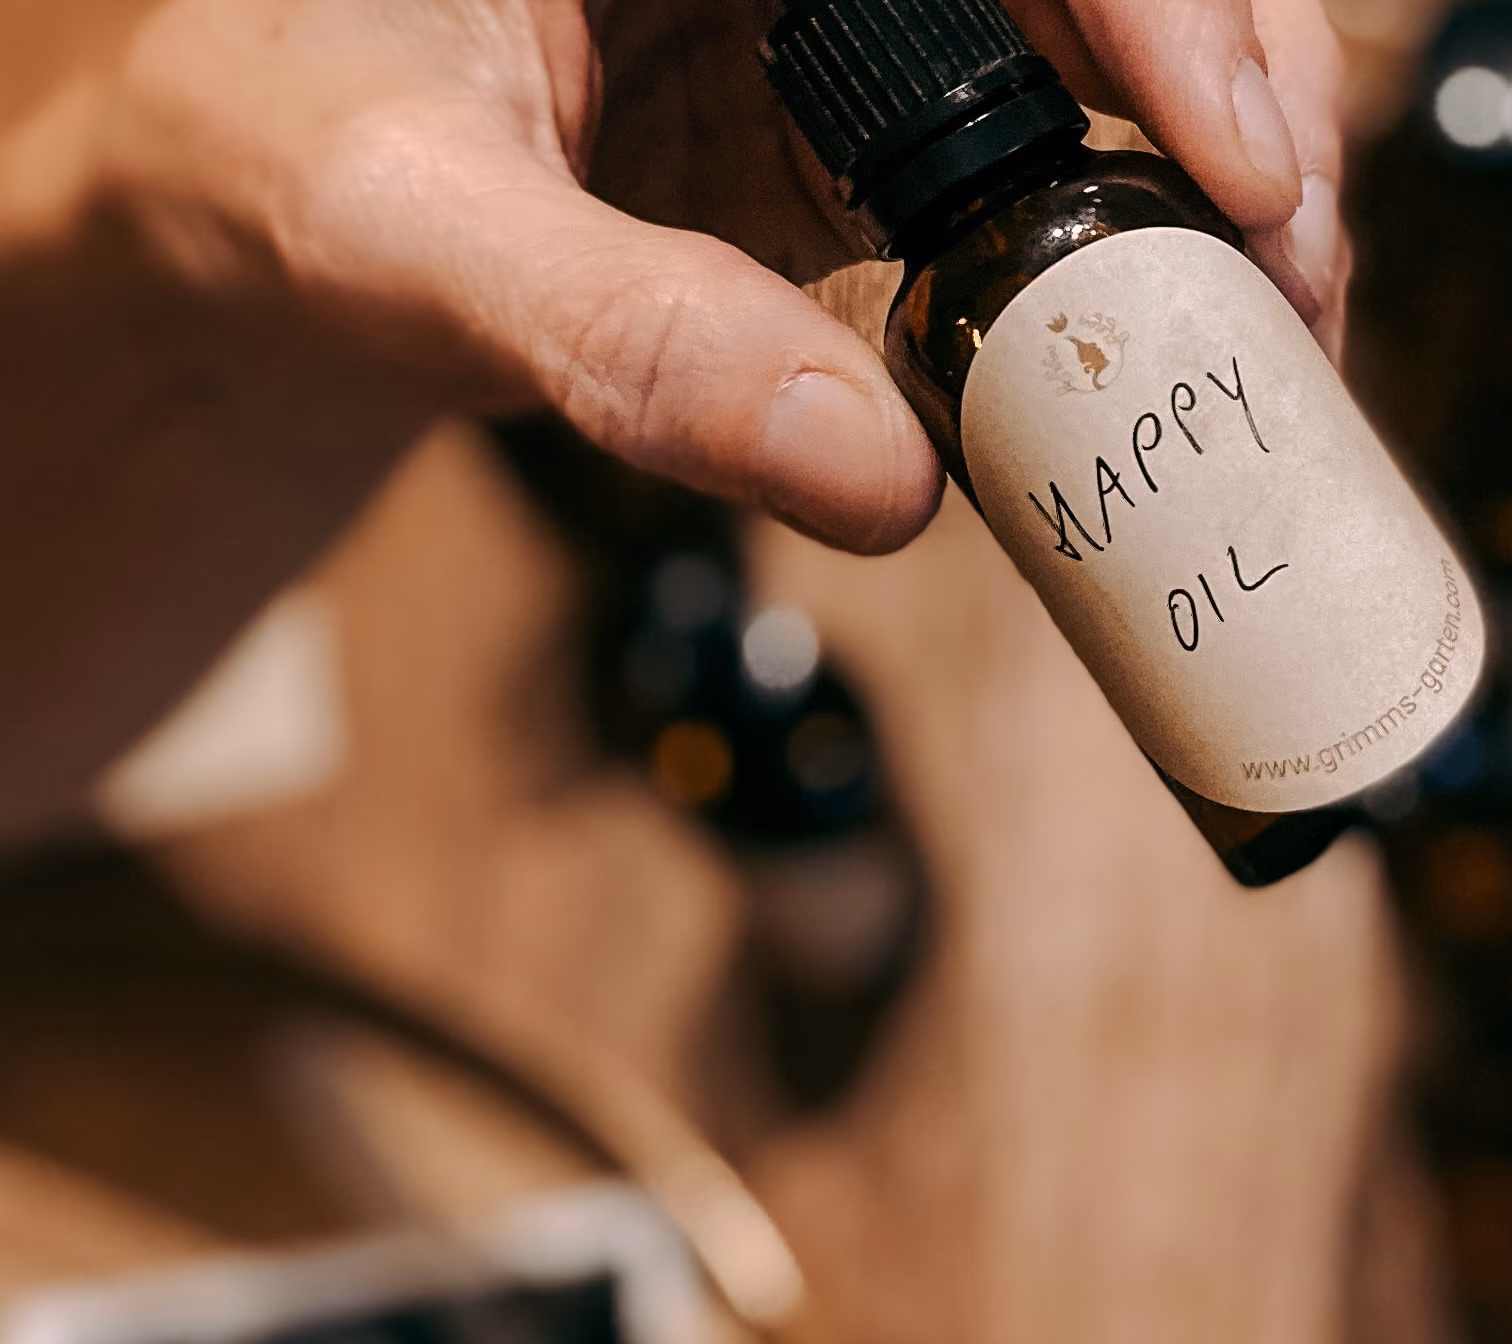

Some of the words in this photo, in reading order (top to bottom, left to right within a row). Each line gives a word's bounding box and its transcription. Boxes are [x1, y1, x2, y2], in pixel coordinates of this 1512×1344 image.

[1028, 357, 1270, 561] HAPPY
[1168, 546, 1289, 652] OIL
[1240, 558, 1463, 782] www.grimms-garten.com
